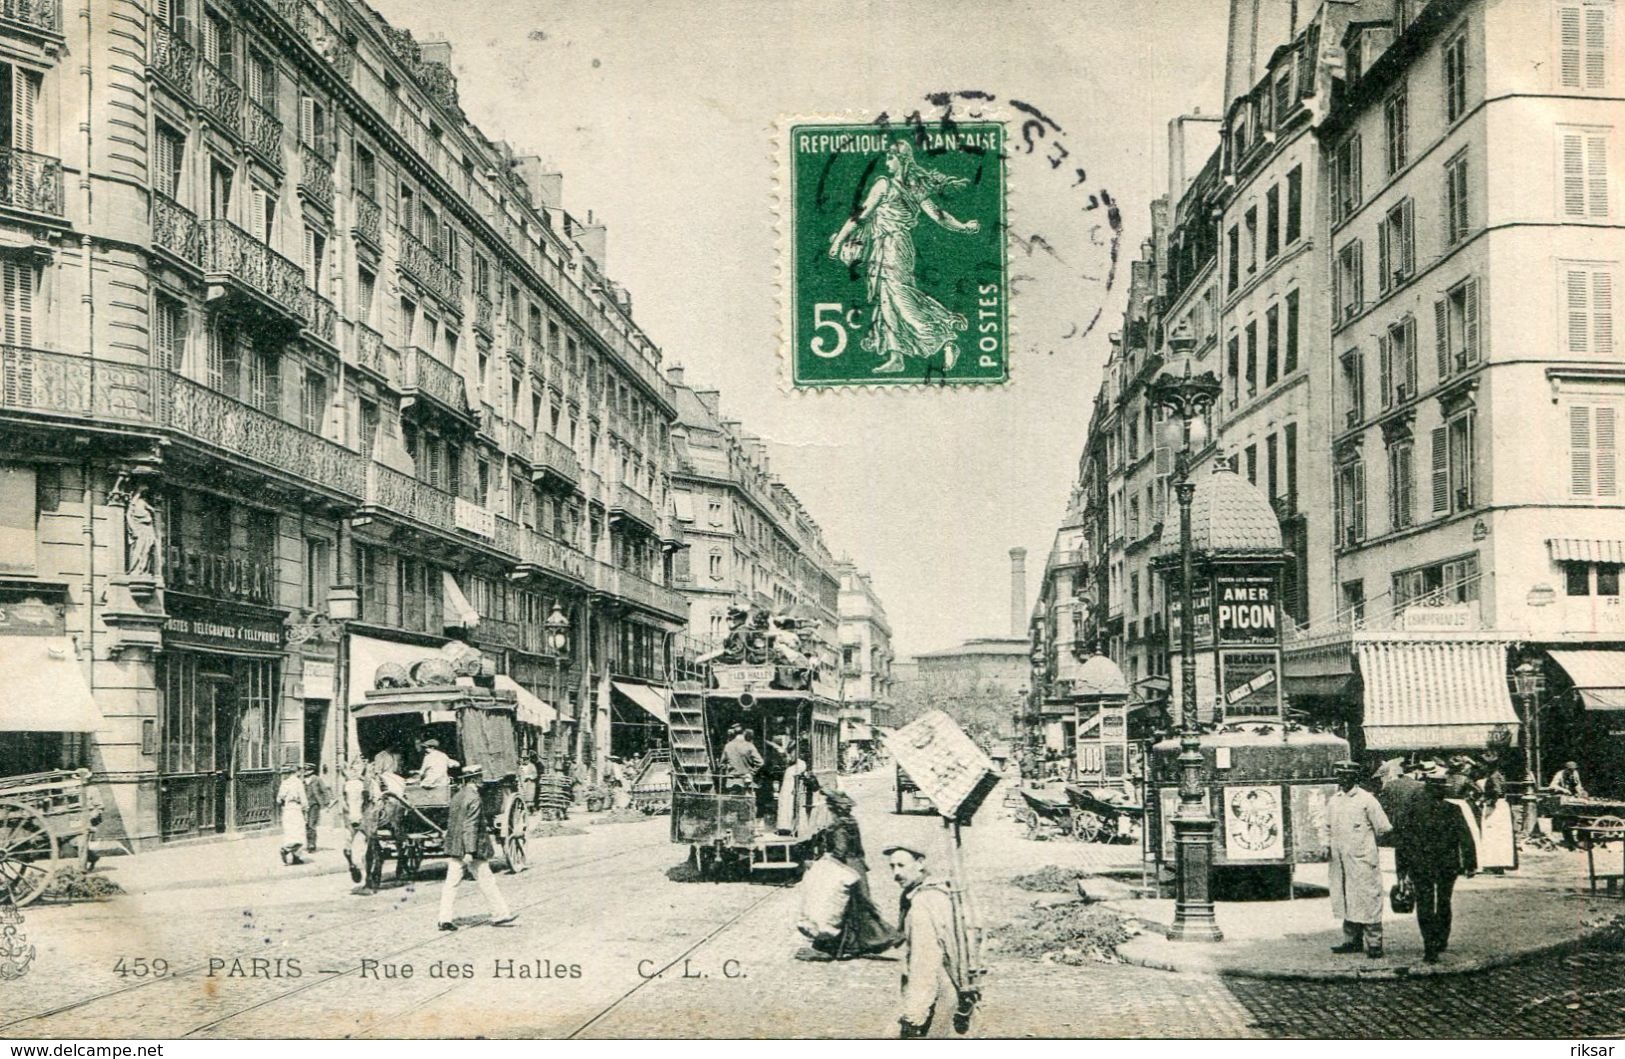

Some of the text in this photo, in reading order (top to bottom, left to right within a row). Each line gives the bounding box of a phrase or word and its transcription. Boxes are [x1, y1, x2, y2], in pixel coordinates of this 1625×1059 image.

[915, 132, 997, 150] RANAISE
[978, 284, 998, 368] POSTES
[1223, 587, 1269, 601] AMER
[1218, 604, 1276, 629] PICON
